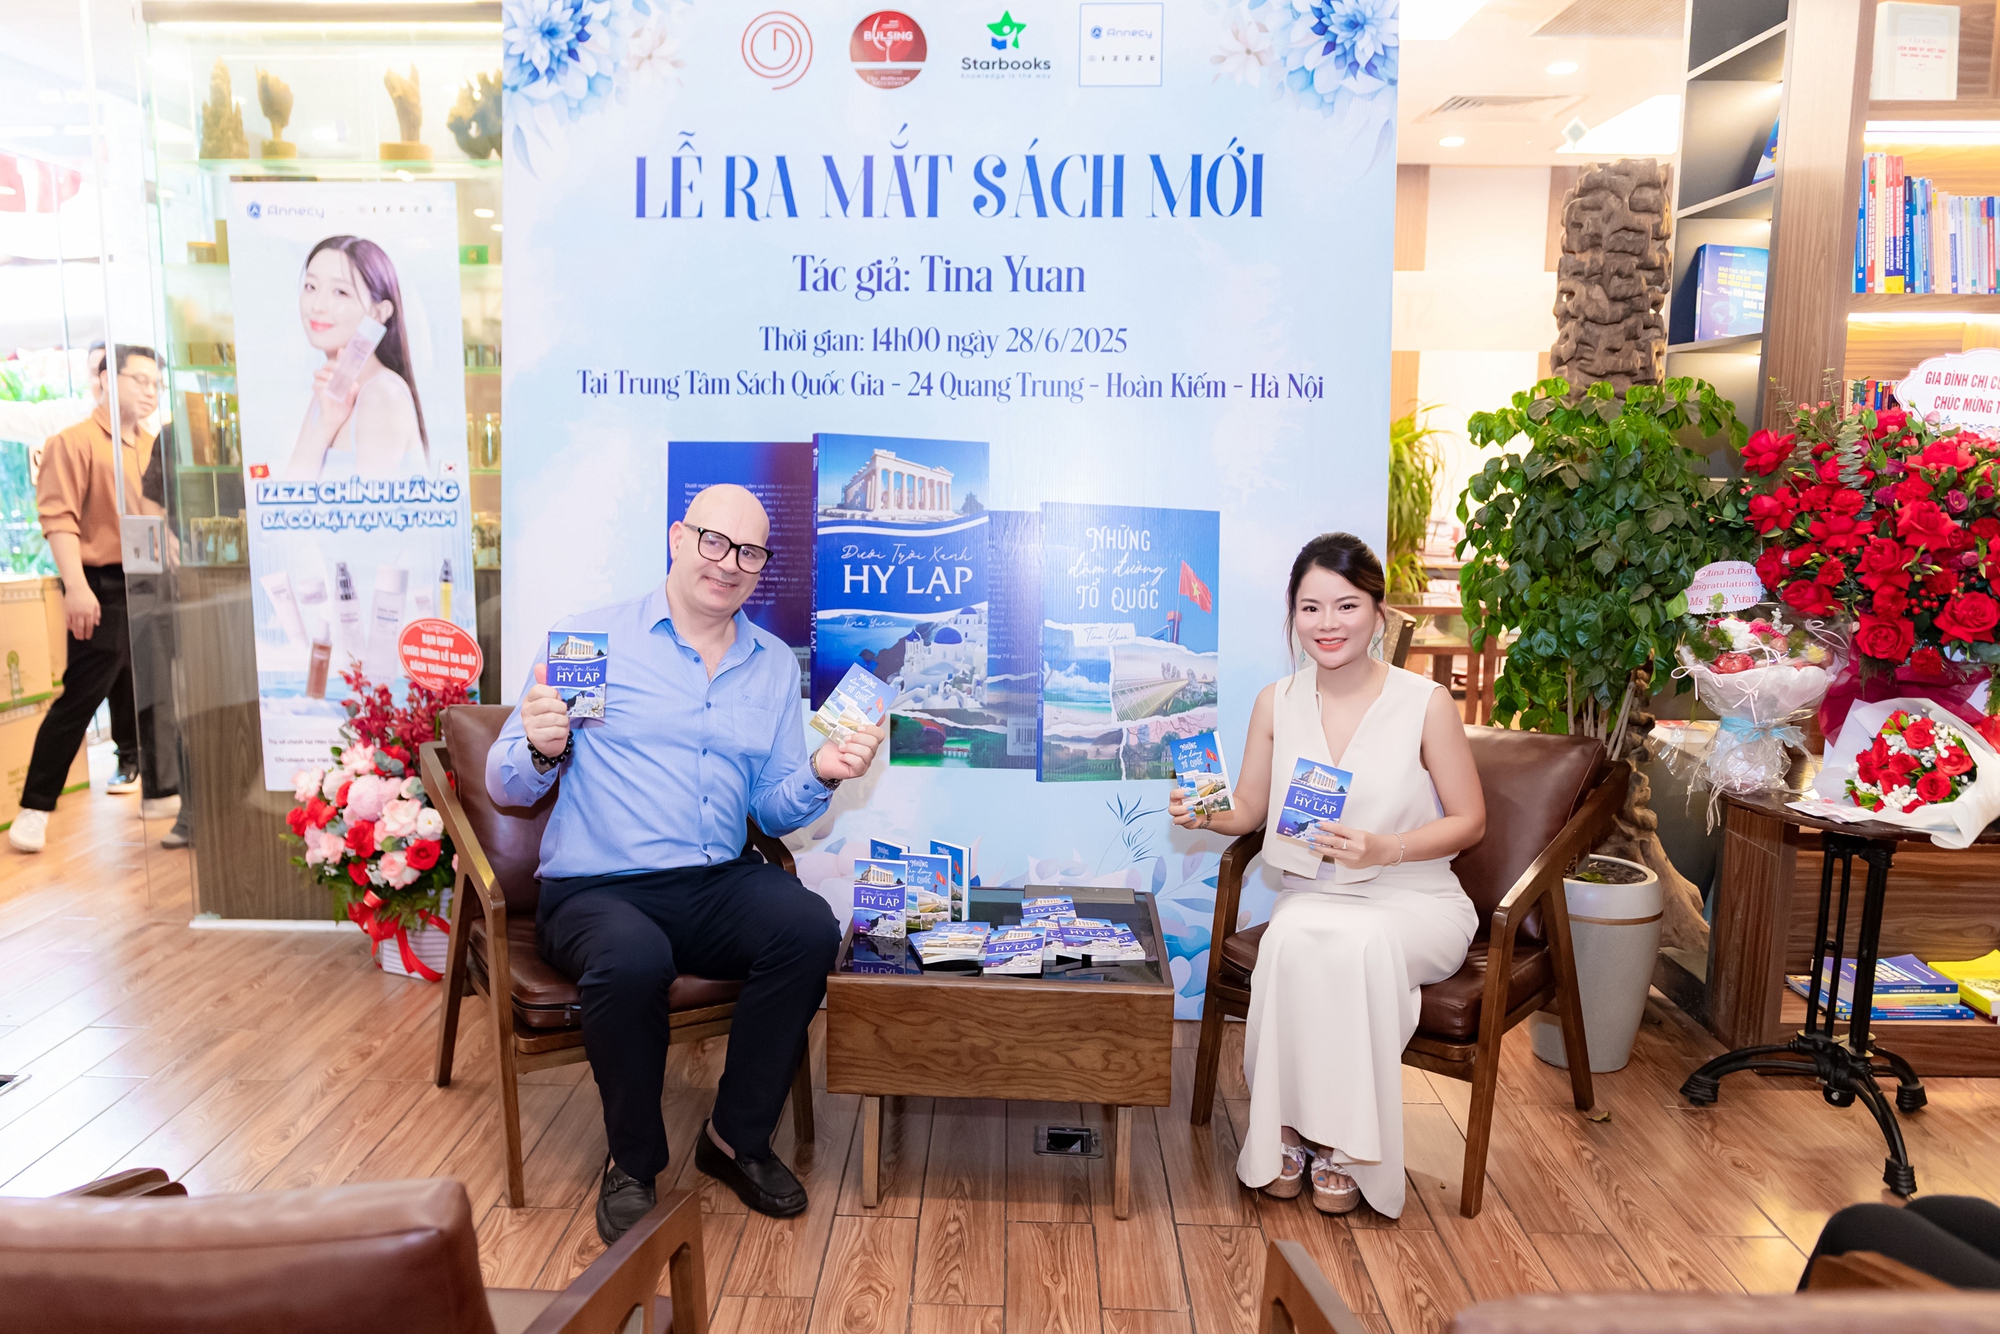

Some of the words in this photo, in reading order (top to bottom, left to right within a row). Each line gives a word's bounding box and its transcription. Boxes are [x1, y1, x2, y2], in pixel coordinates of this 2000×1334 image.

[1106, 28, 1153, 39] Annecy
[961, 57, 1051, 70] Starbooks
[635, 131, 702, 219] LỄ
[724, 155, 798, 221] RA
[821, 123, 953, 219] MẮT
[973, 138, 1125, 219] SÁCH
[1146, 136, 1265, 219] MỚI
[267, 204, 325, 218] Annecy
[792, 255, 846, 292] Tác
[855, 256, 909, 301] giả:
[921, 255, 993, 292] Tina
[1002, 255, 1086, 293] Yuan
[759, 326, 807, 351] Thời
[813, 329, 864, 358] gian:
[872, 326, 940, 351] 14h00
[947, 330, 999, 358] ngày
[1005, 327, 1128, 353] 28/6/2025
[577, 369, 608, 398] Tại
[614, 369, 680, 401] Trung
[685, 369, 730, 396] Tâm
[736, 369, 785, 396] Sách
[791, 370, 845, 400] Quốc
[850, 370, 885, 397] Gia
[907, 371, 933, 397] 24
[939, 371, 1011, 403] Quang
[1016, 372, 1084, 403] Trung
[1105, 372, 1163, 398] Hoàn
[1170, 371, 1226, 398] Kiếm
[1250, 373, 1279, 399] Hà
[1287, 373, 1324, 402] Nội
[1926, 371, 1941, 385] GIA
[1944, 370, 1969, 387] ĐÌNH
[1971, 374, 1988, 392] CHỊ
[1934, 394, 1960, 410] CHÚC
[257, 482, 317, 504] IZEZE
[317, 475, 391, 504] CHÍNH
[287, 508, 315, 529] CÓ
[417, 510, 457, 528] NAM
[928, 546, 973, 562] Xanh
[843, 564, 895, 594] HY
[906, 564, 973, 602] LẠP
[1111, 581, 1159, 613] QUỐC
[1690, 597, 1703, 606] Ms
[1732, 594, 1758, 604] Yuan
[810, 612, 817, 628] HY
[557, 672, 575, 682] HY
[577, 672, 600, 684] LẠP
[1293, 795, 1312, 808] HY
[1313, 801, 1337, 815] LẠP
[861, 895, 876, 904] HY
[879, 896, 900, 908] LẠP
[995, 944, 1013, 952] HY
